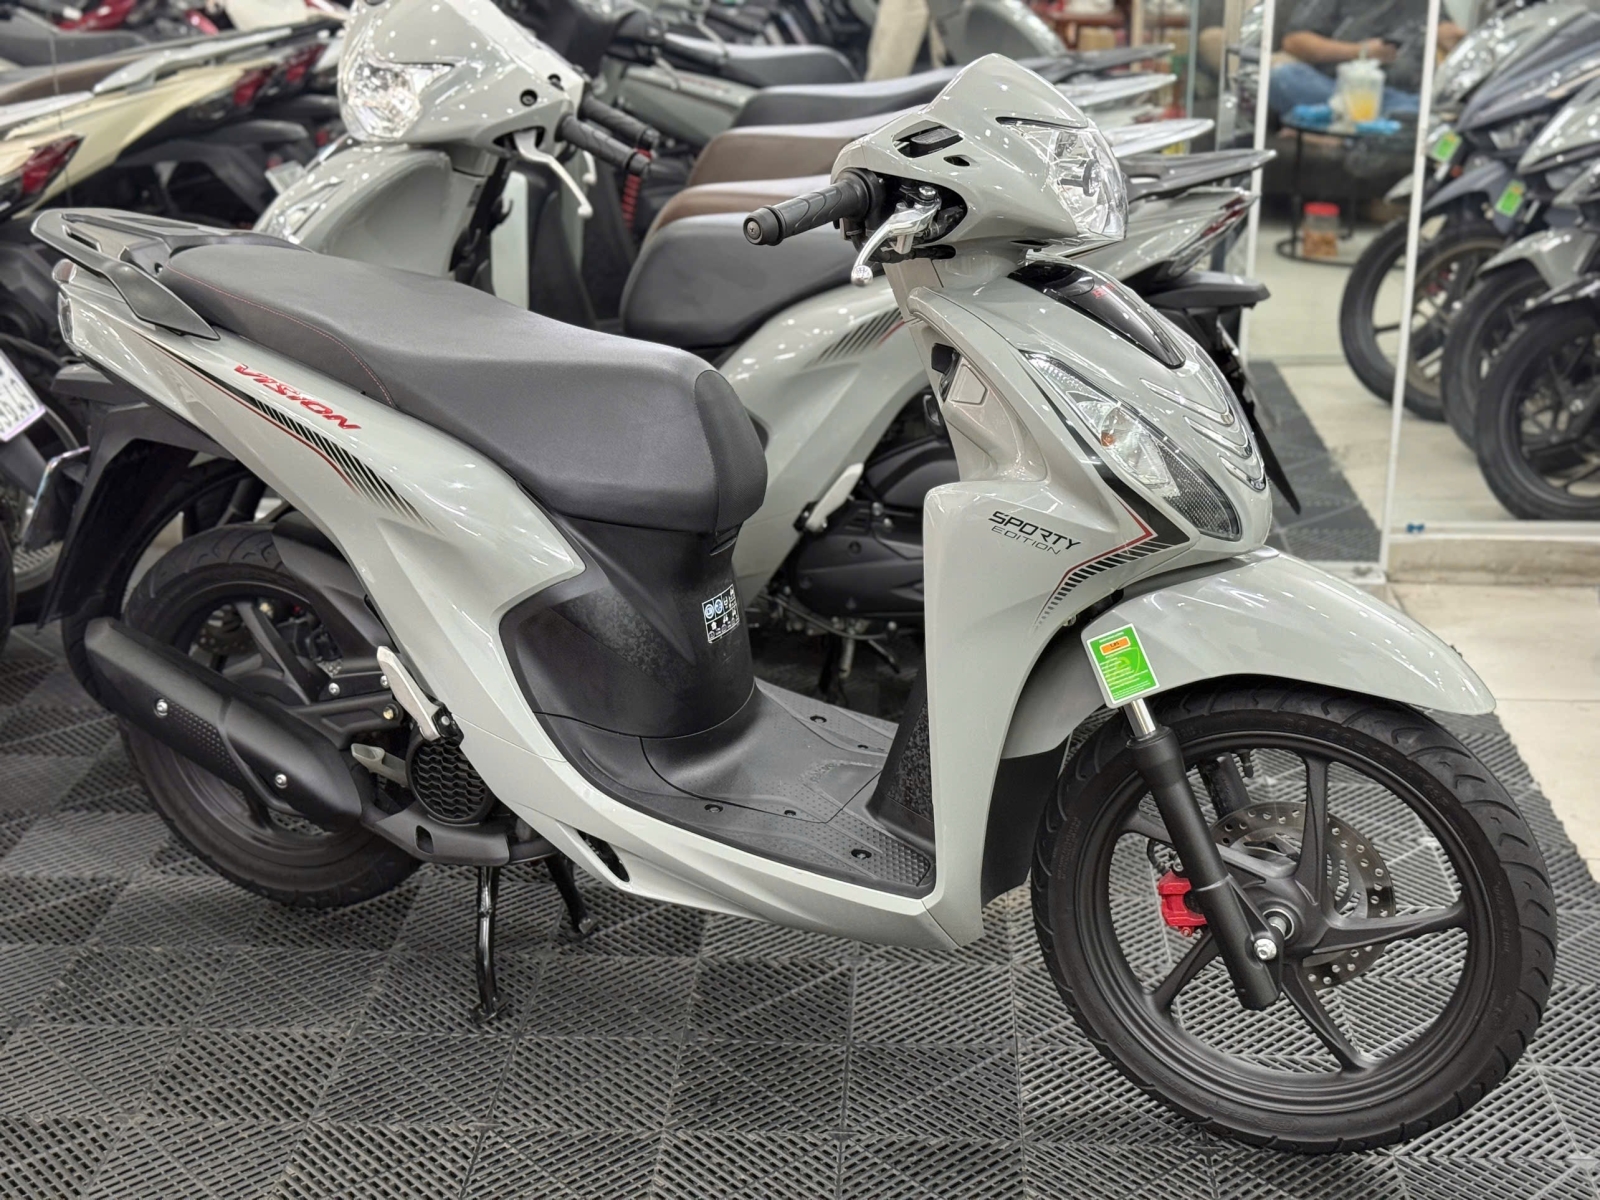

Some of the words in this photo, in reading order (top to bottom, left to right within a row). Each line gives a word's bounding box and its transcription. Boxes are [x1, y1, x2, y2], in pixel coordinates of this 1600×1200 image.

[234, 364, 362, 430] VISION
[988, 510, 1082, 550] SPORTY
[991, 525, 1061, 555] EDITION
